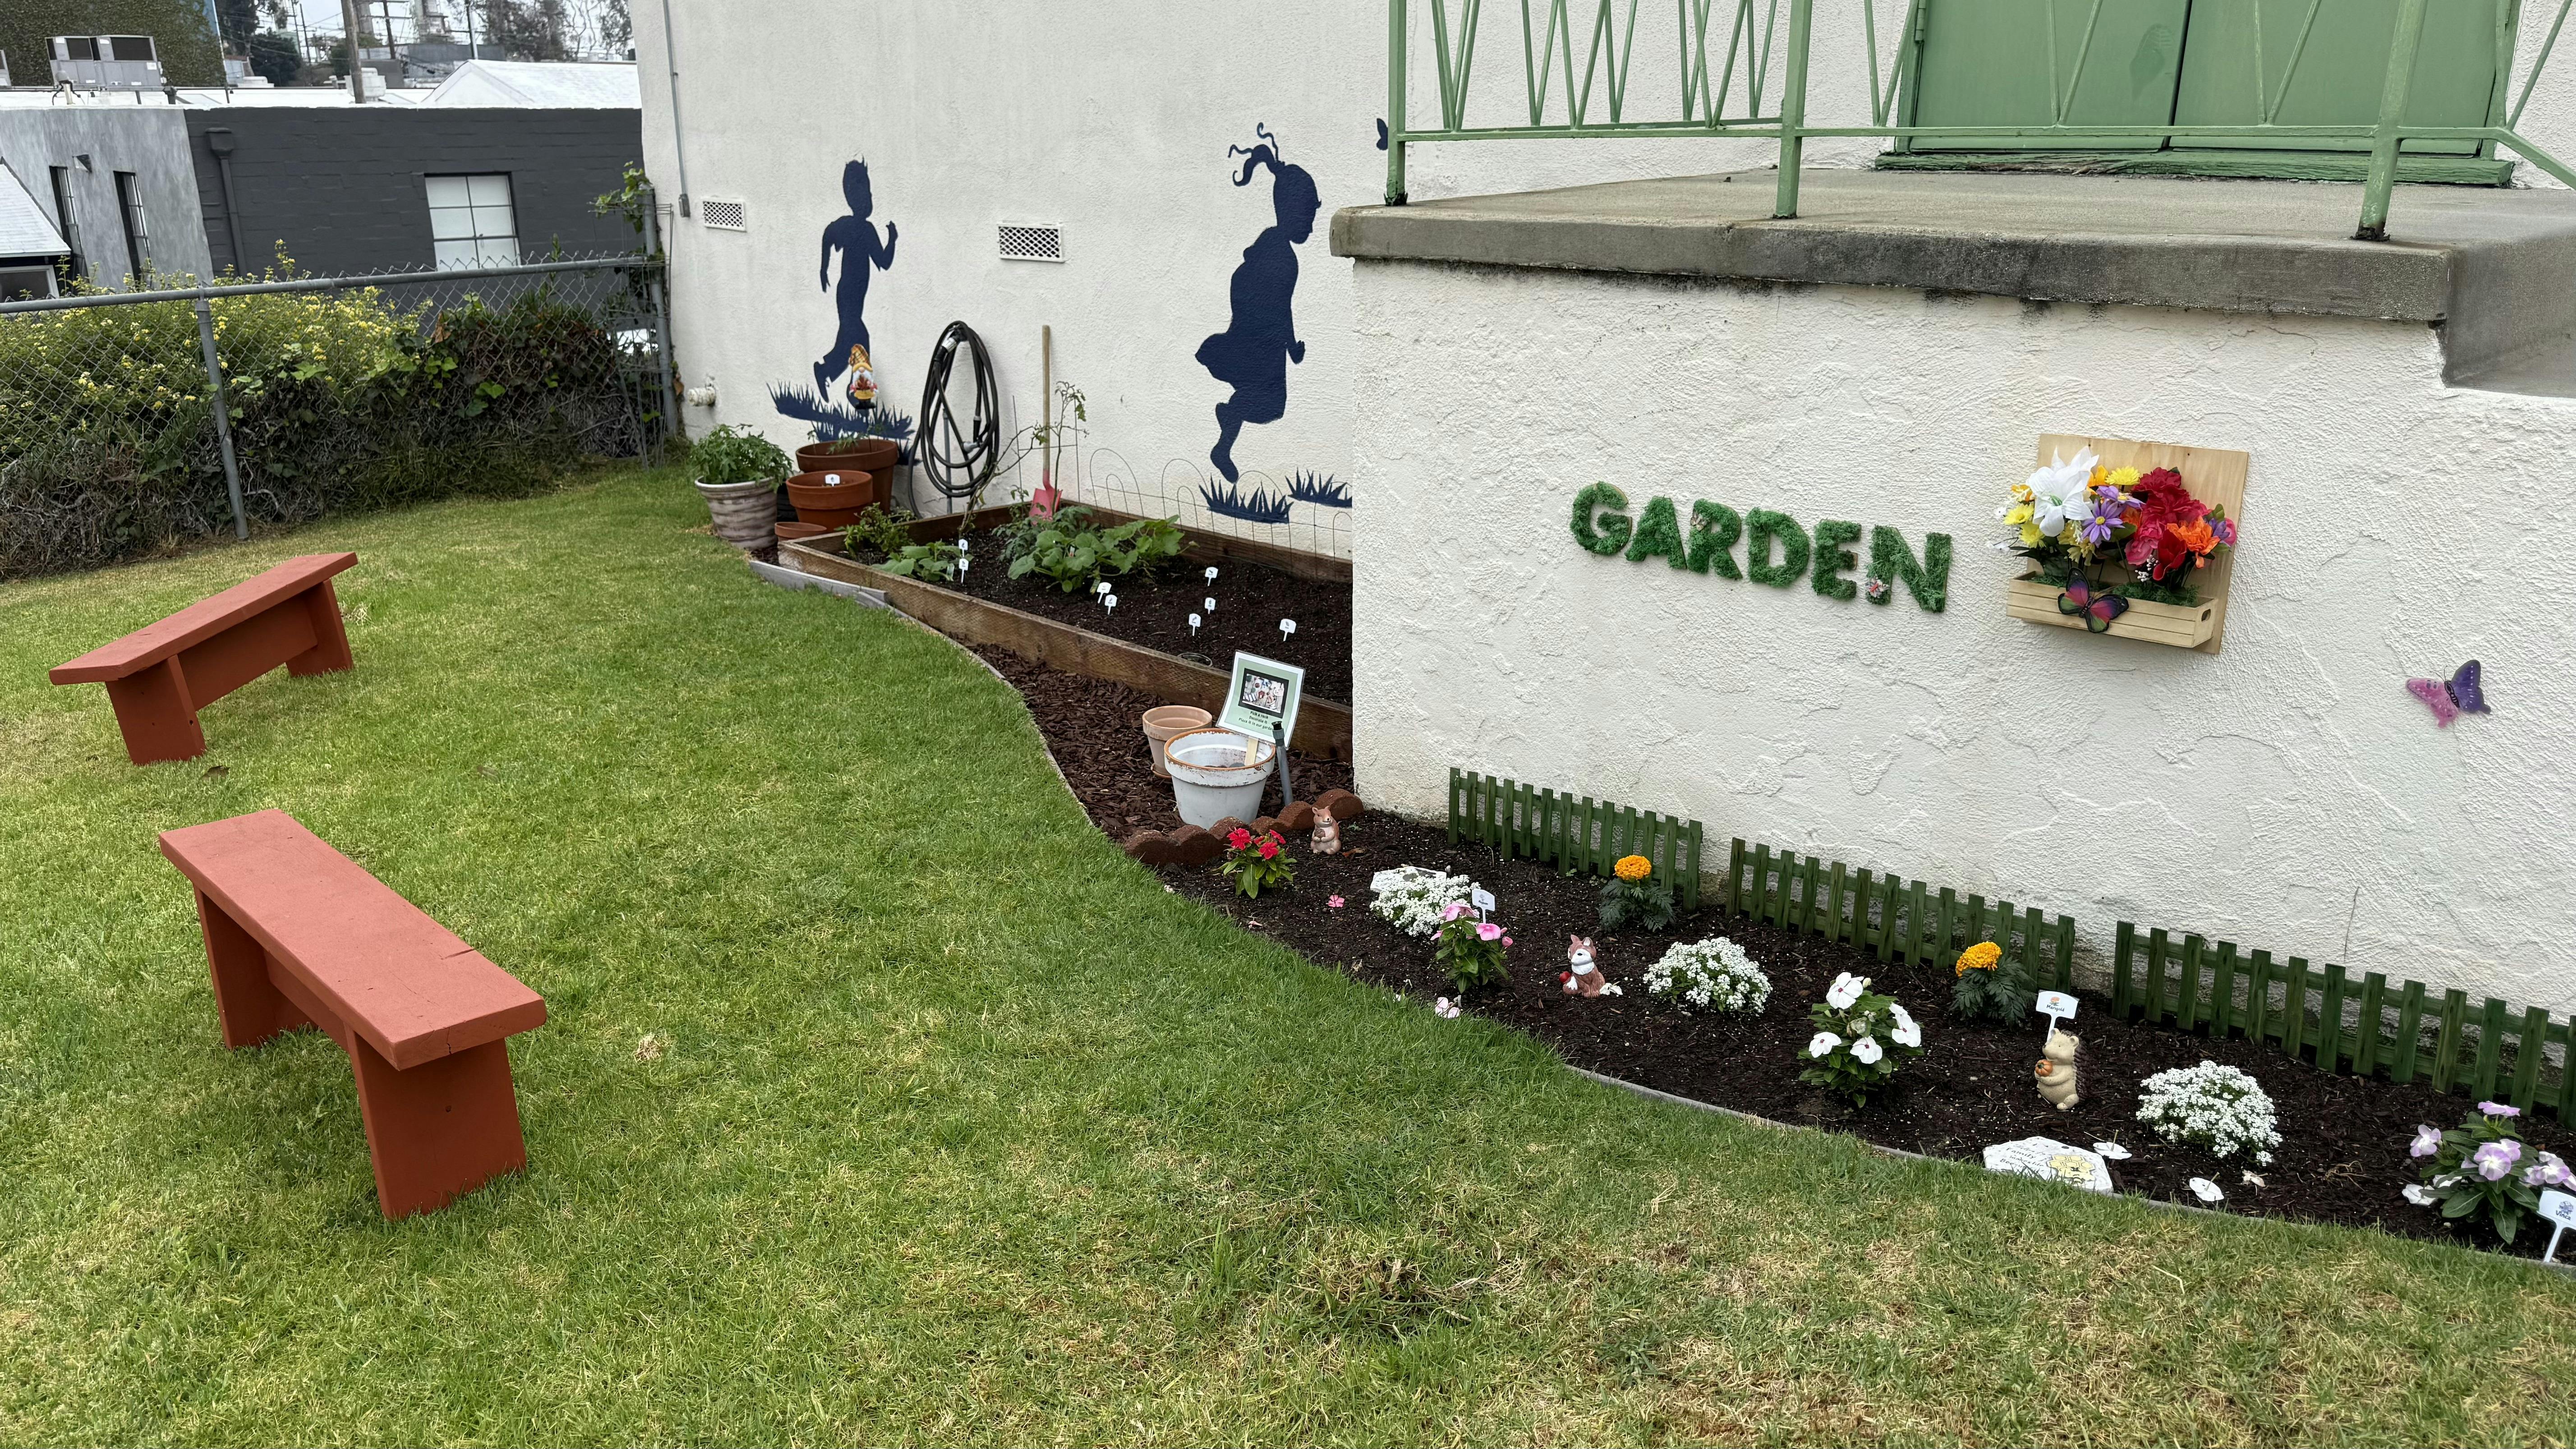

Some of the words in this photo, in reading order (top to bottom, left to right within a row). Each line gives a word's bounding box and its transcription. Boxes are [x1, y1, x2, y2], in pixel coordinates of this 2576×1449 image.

[1569, 481, 1952, 613] GARDEN
[2006, 1147, 2036, 1159] Family
[2555, 1210, 2571, 1221] Vinca
